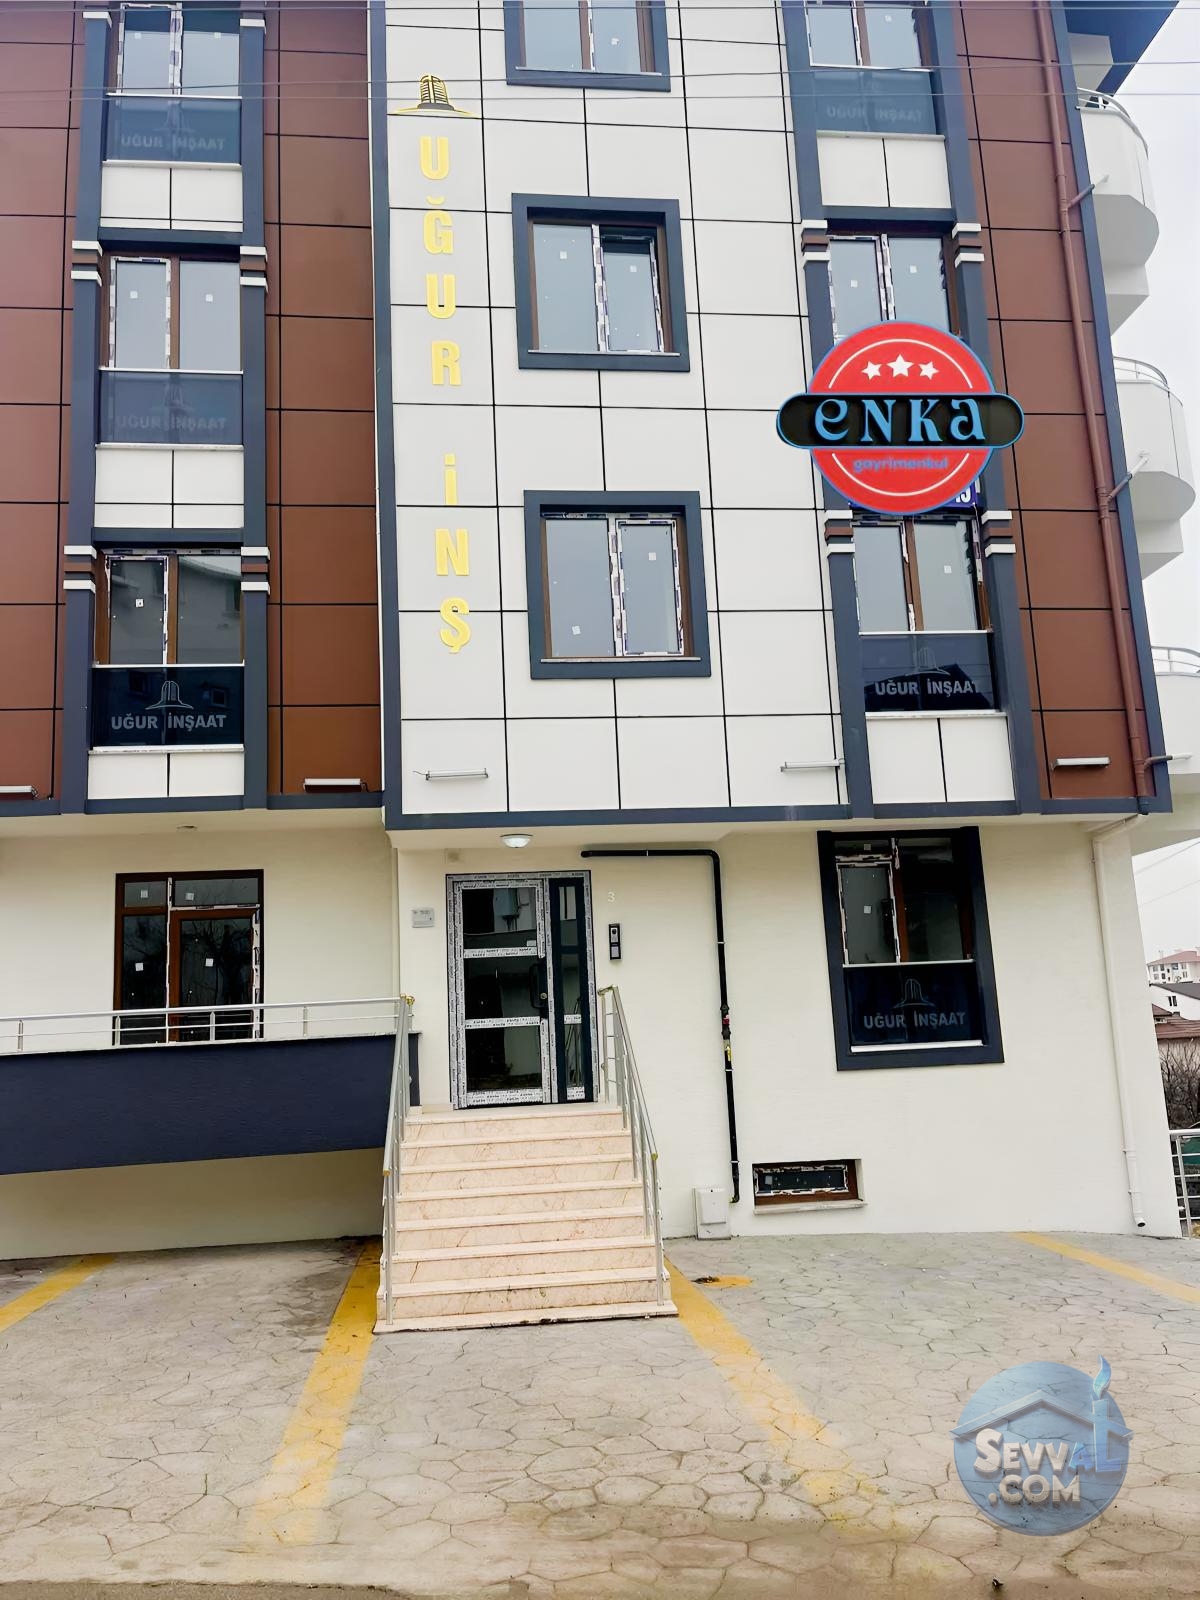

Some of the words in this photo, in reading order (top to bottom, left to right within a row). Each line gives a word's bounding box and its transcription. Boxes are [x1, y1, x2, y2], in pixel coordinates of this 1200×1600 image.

[874, 680, 919, 696] UĞUR
[927, 679, 981, 697] İNŞAAT
[111, 713, 159, 730] UĞUR
[167, 712, 227, 731] İNŞAAT
[607, 891, 616, 903] 3
[864, 1012, 906, 1029] UĞUR
[913, 1010, 966, 1029] İNŞAAT
